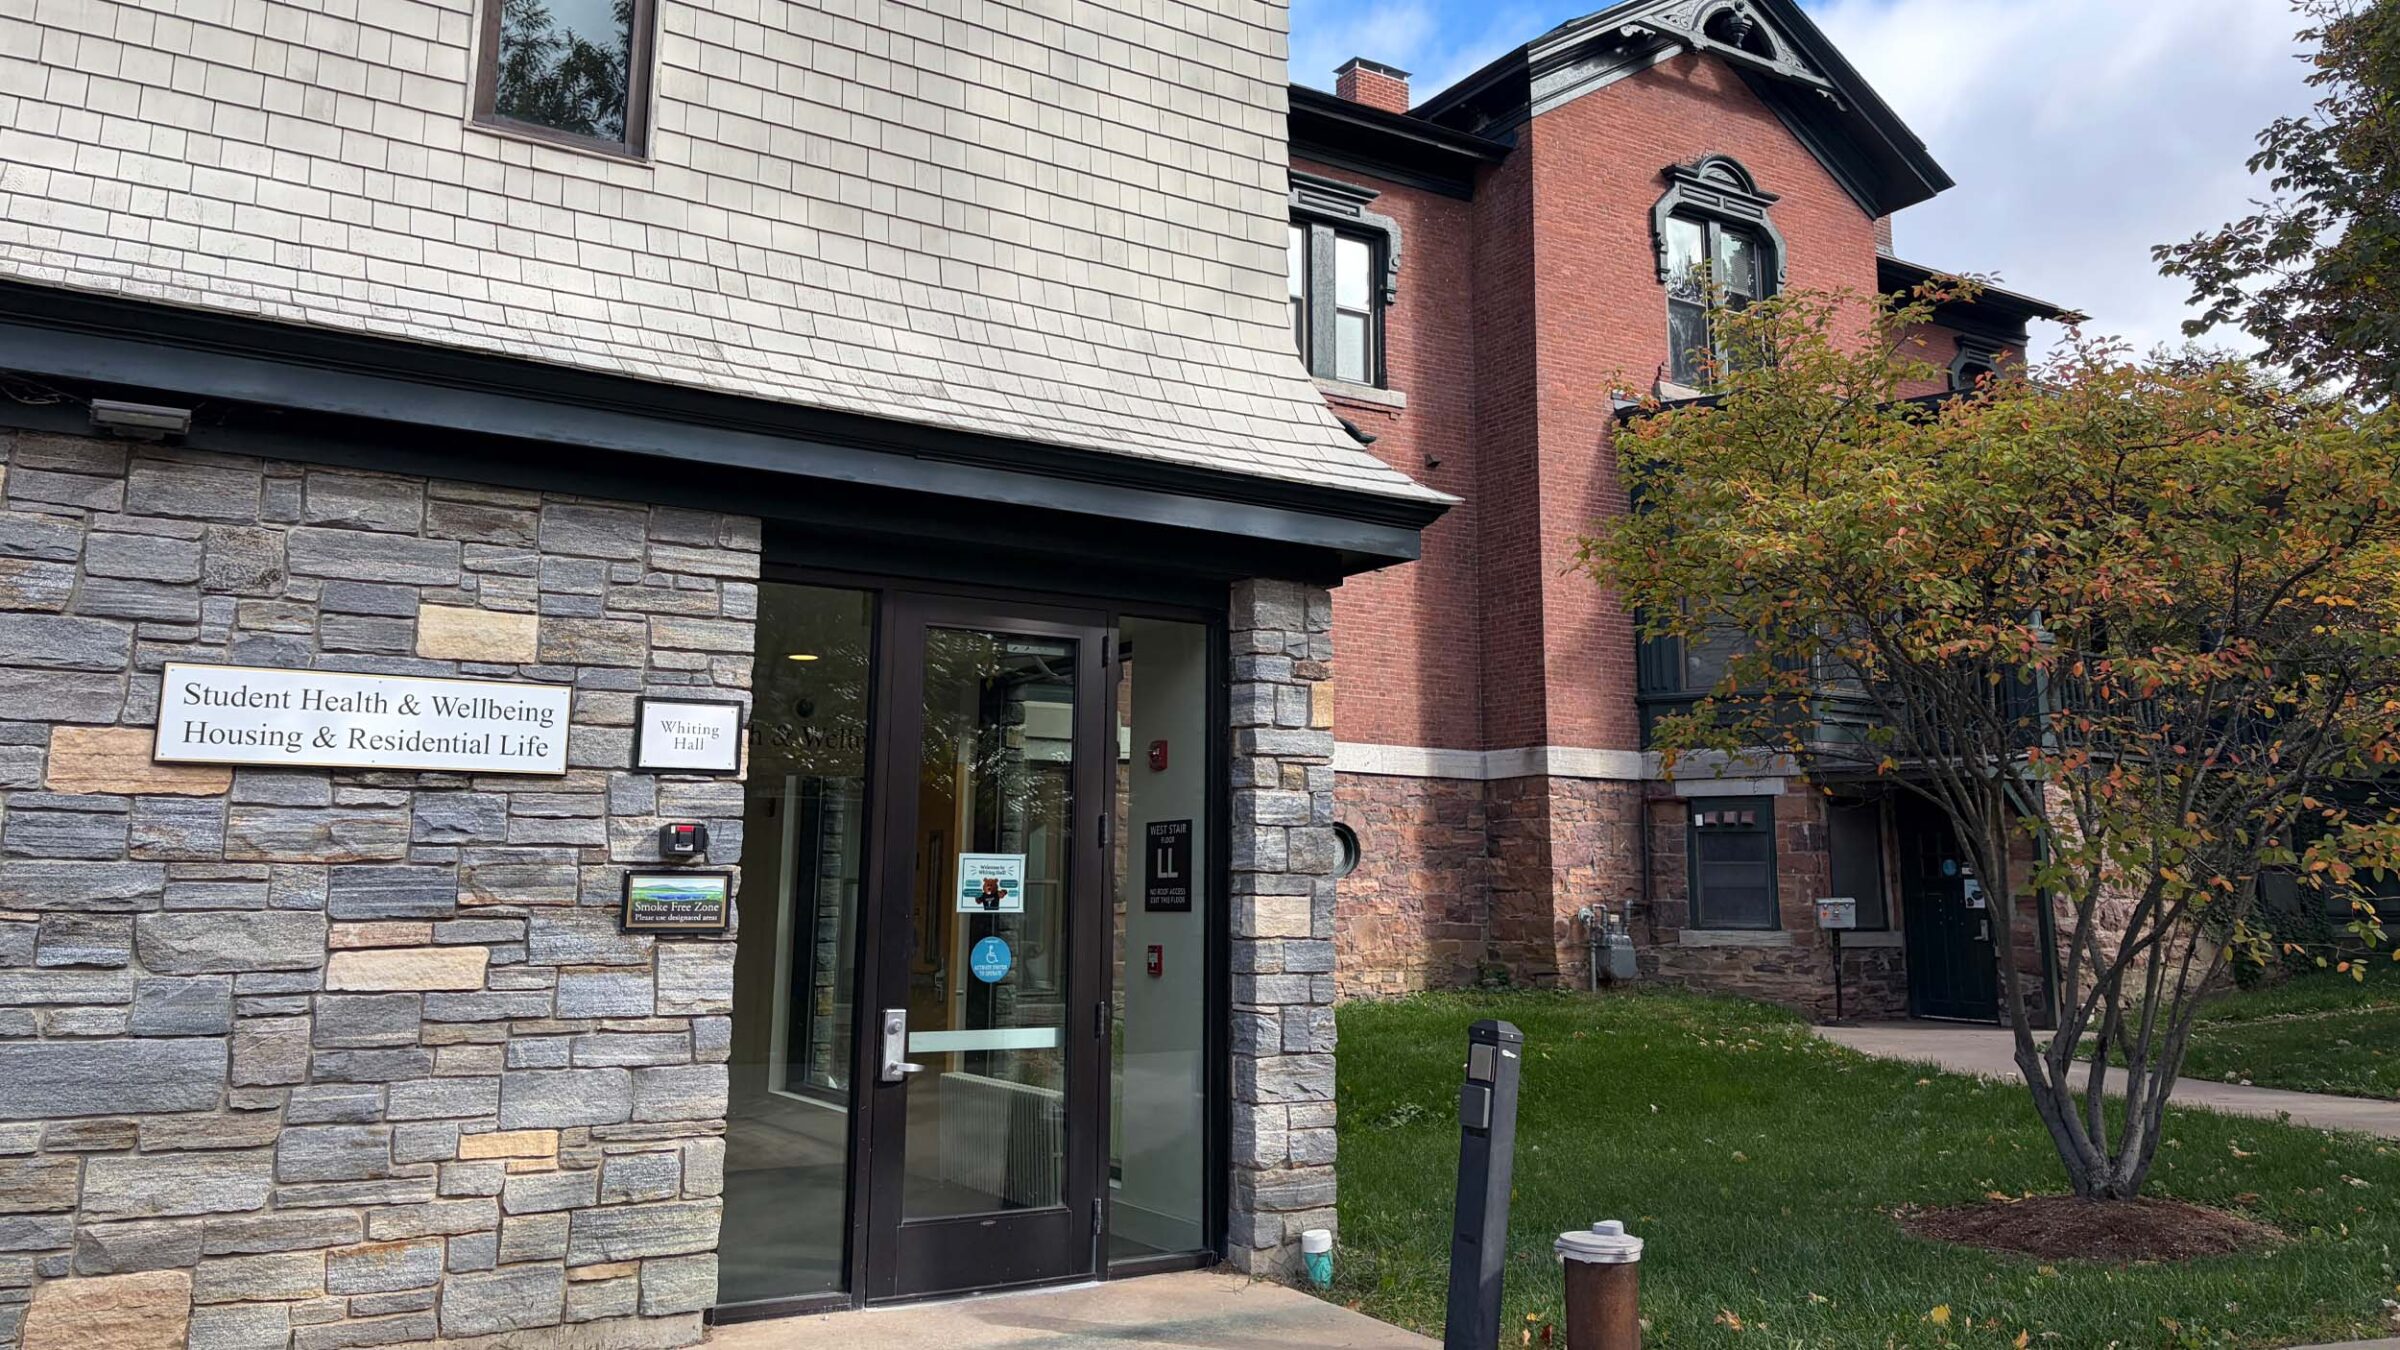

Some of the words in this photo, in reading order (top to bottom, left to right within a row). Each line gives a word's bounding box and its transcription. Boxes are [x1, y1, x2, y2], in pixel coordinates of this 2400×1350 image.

[183, 682, 291, 710] Student
[300, 688, 388, 714] Health
[397, 693, 422, 717] &
[431, 695, 555, 729] Wellbeing
[660, 720, 720, 740] Whiting
[182, 720, 304, 754] Housing
[312, 725, 337, 750] &
[346, 727, 490, 755] Residential
[499, 734, 549, 758] Life
[674, 737, 704, 751] Hall
[1150, 825, 1168, 836] WEST
[1169, 823, 1187, 835] STAIR
[1157, 847, 1179, 879] LL
[634, 901, 668, 912] Smoke
[671, 901, 692, 912] Free
[694, 901, 719, 912] Zone
[667, 914, 701, 923] designated
